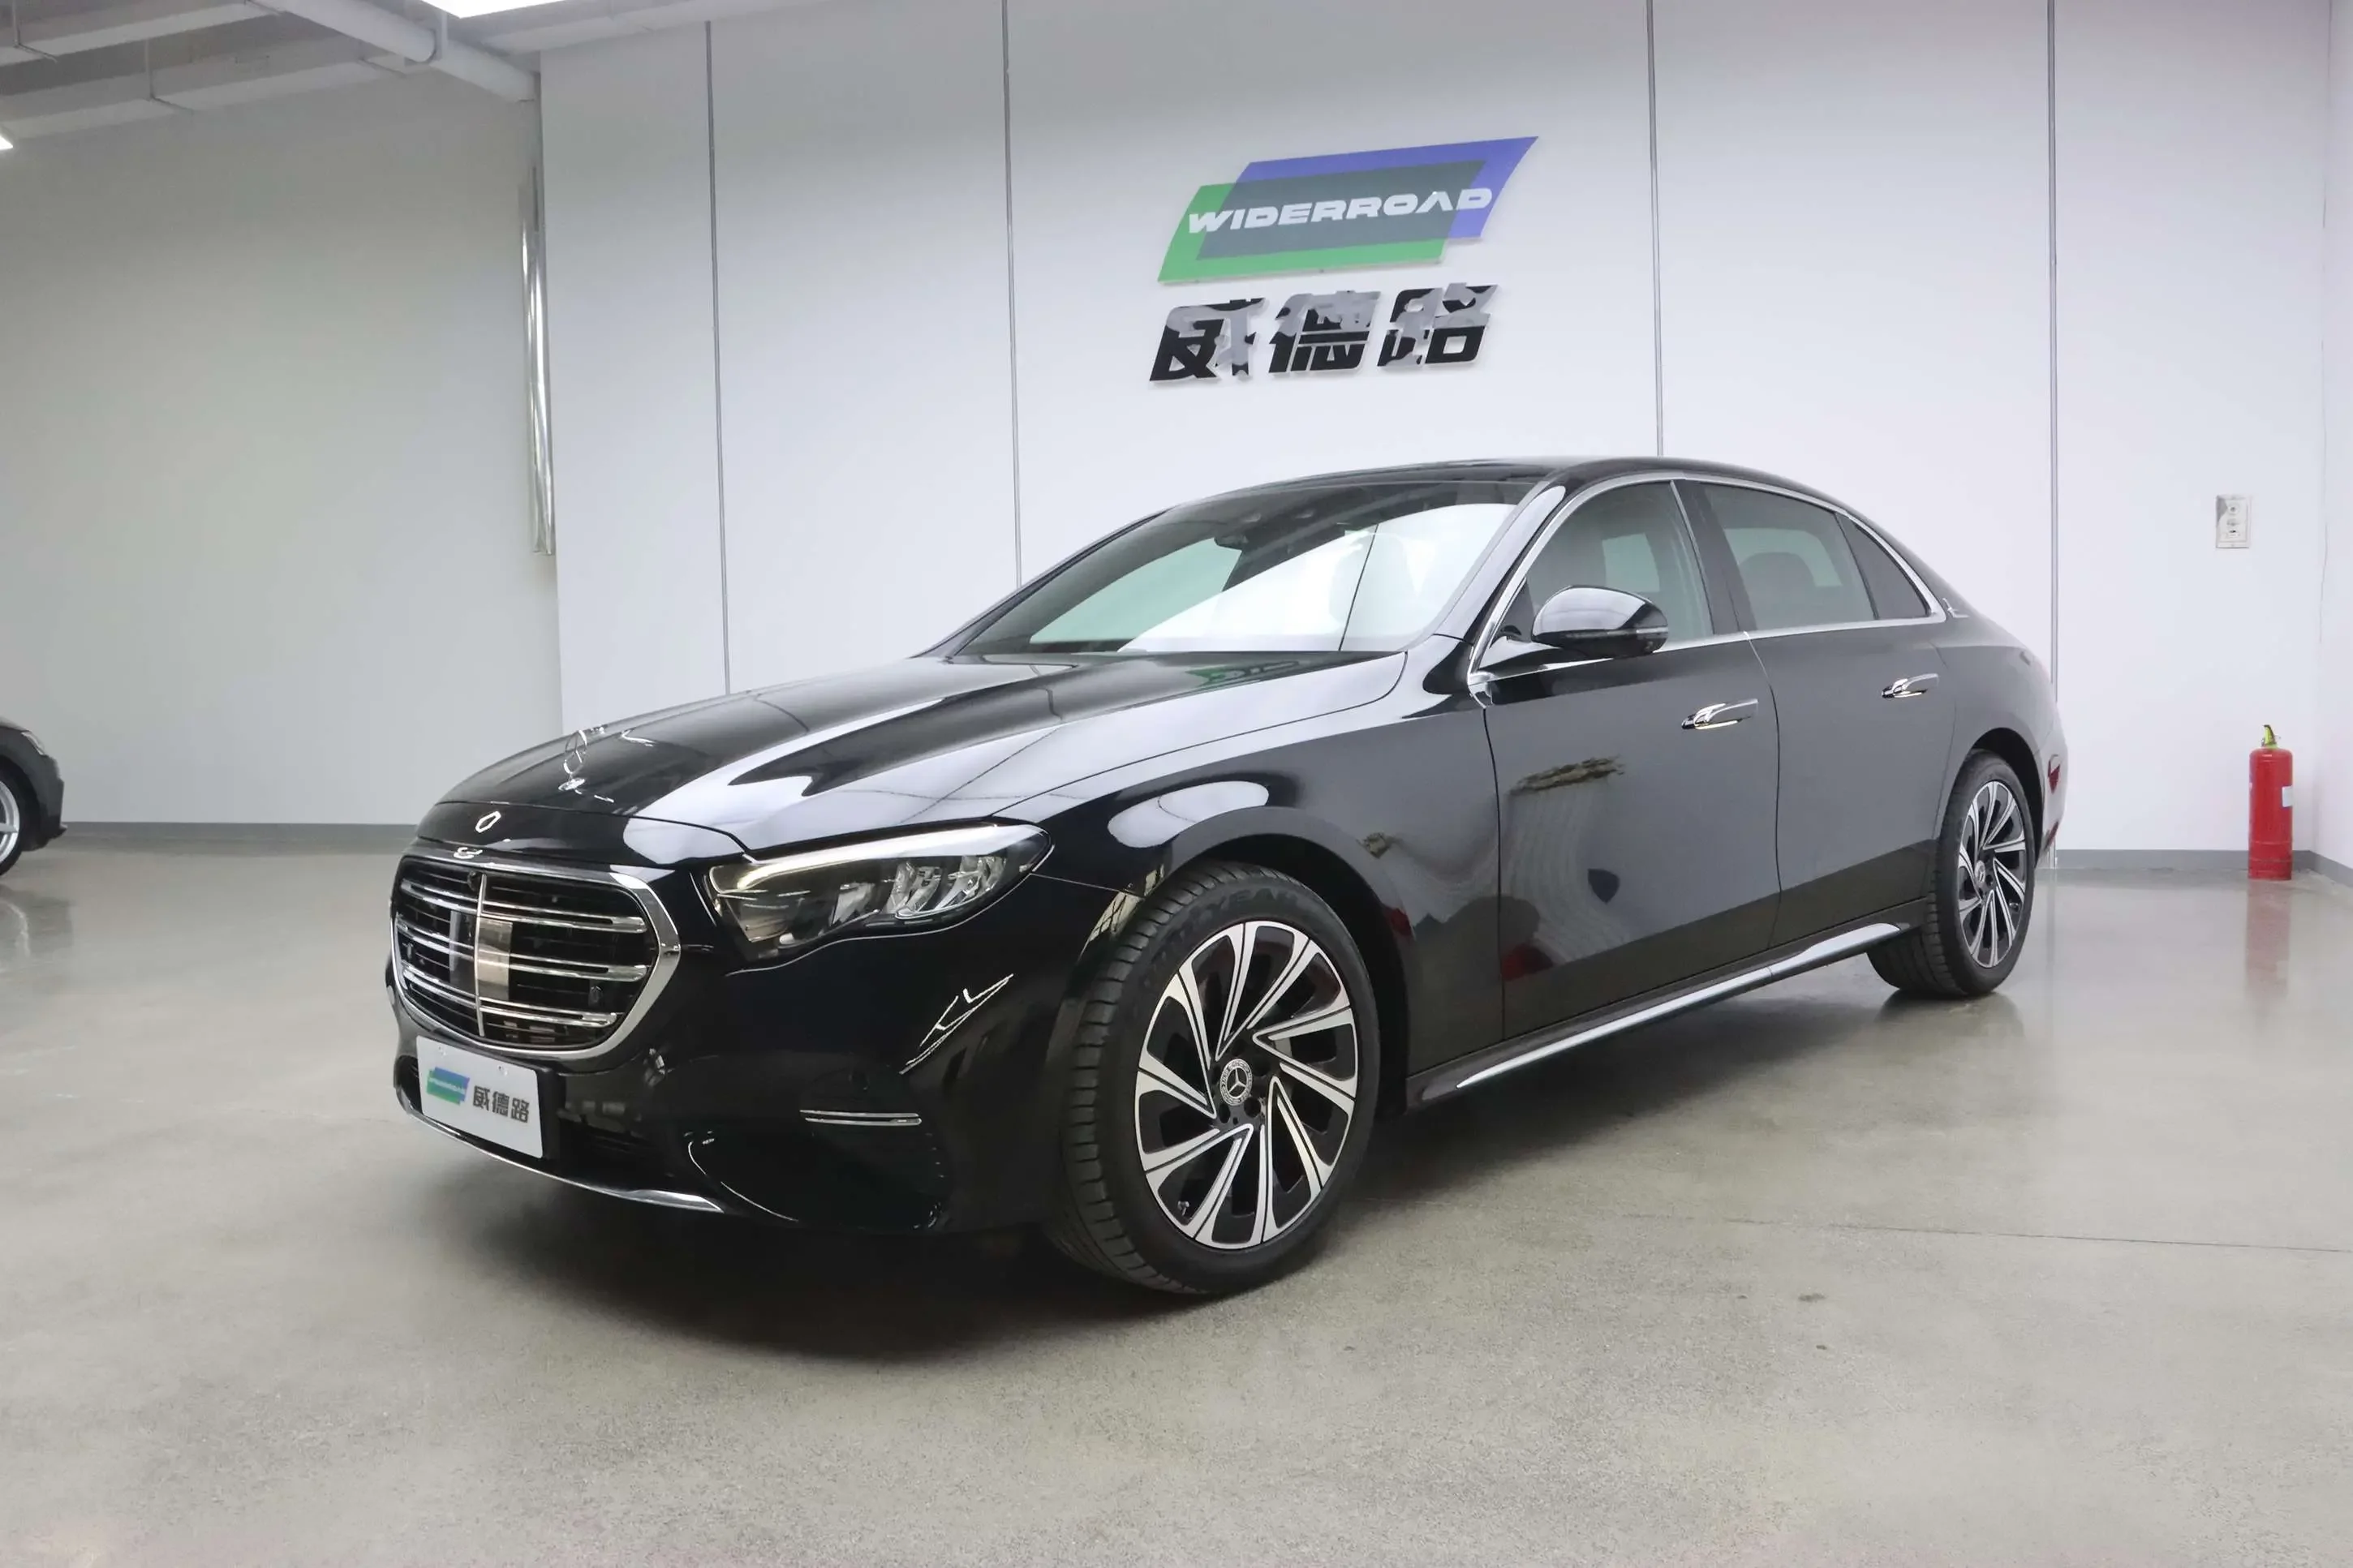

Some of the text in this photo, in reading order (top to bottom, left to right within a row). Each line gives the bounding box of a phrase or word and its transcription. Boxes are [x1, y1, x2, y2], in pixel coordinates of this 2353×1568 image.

[1189, 187, 1492, 234] WIDERROAD
[1149, 282, 1499, 382] 威德路
[473, 1085, 530, 1123] 威德路
